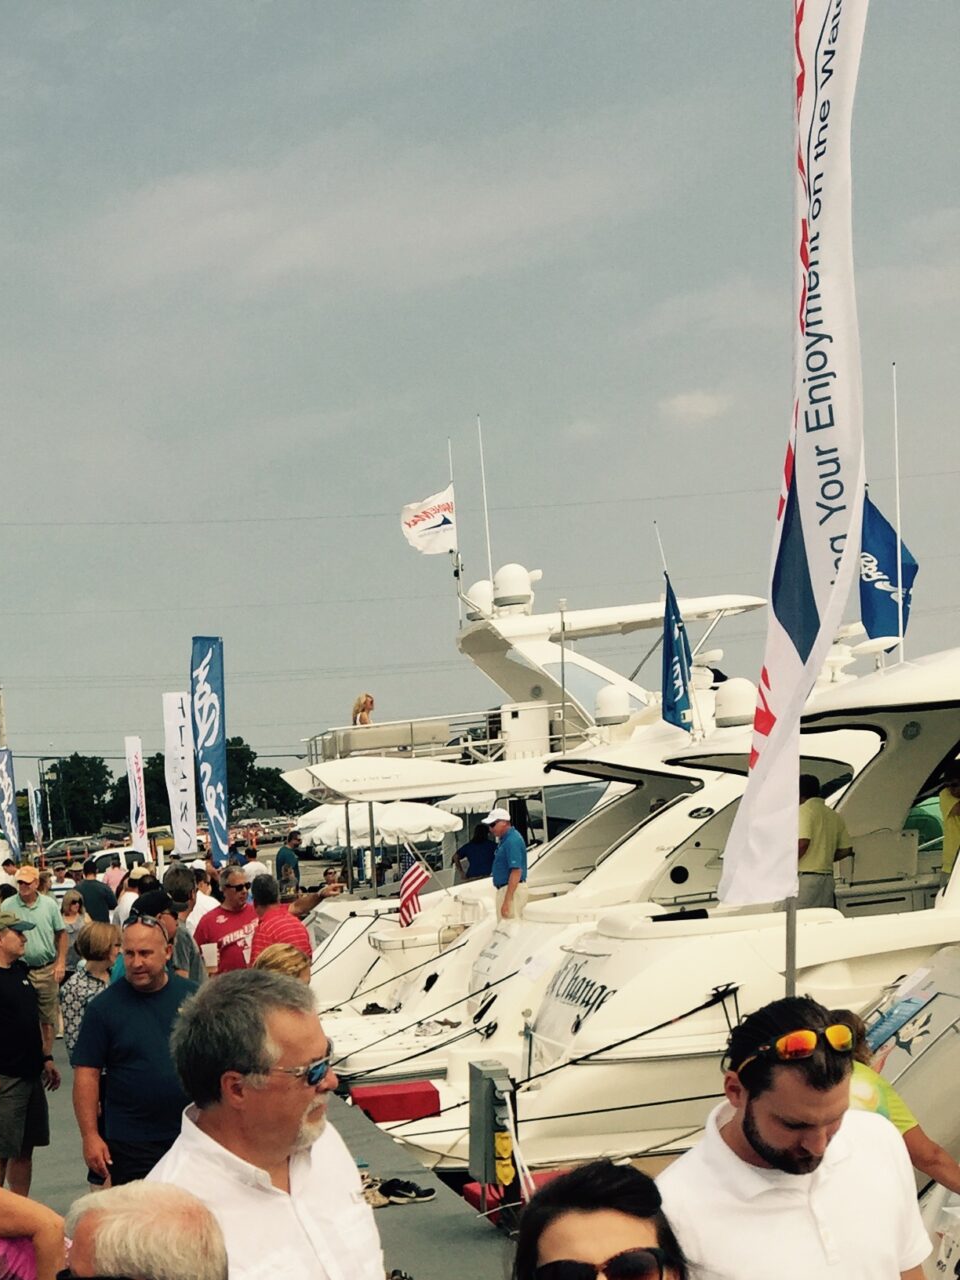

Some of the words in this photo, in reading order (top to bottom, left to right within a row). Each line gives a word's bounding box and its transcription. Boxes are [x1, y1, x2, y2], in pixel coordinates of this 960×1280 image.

[814, 99, 831, 162] the
[810, 172, 825, 221] on
[816, 445, 847, 526] Your
